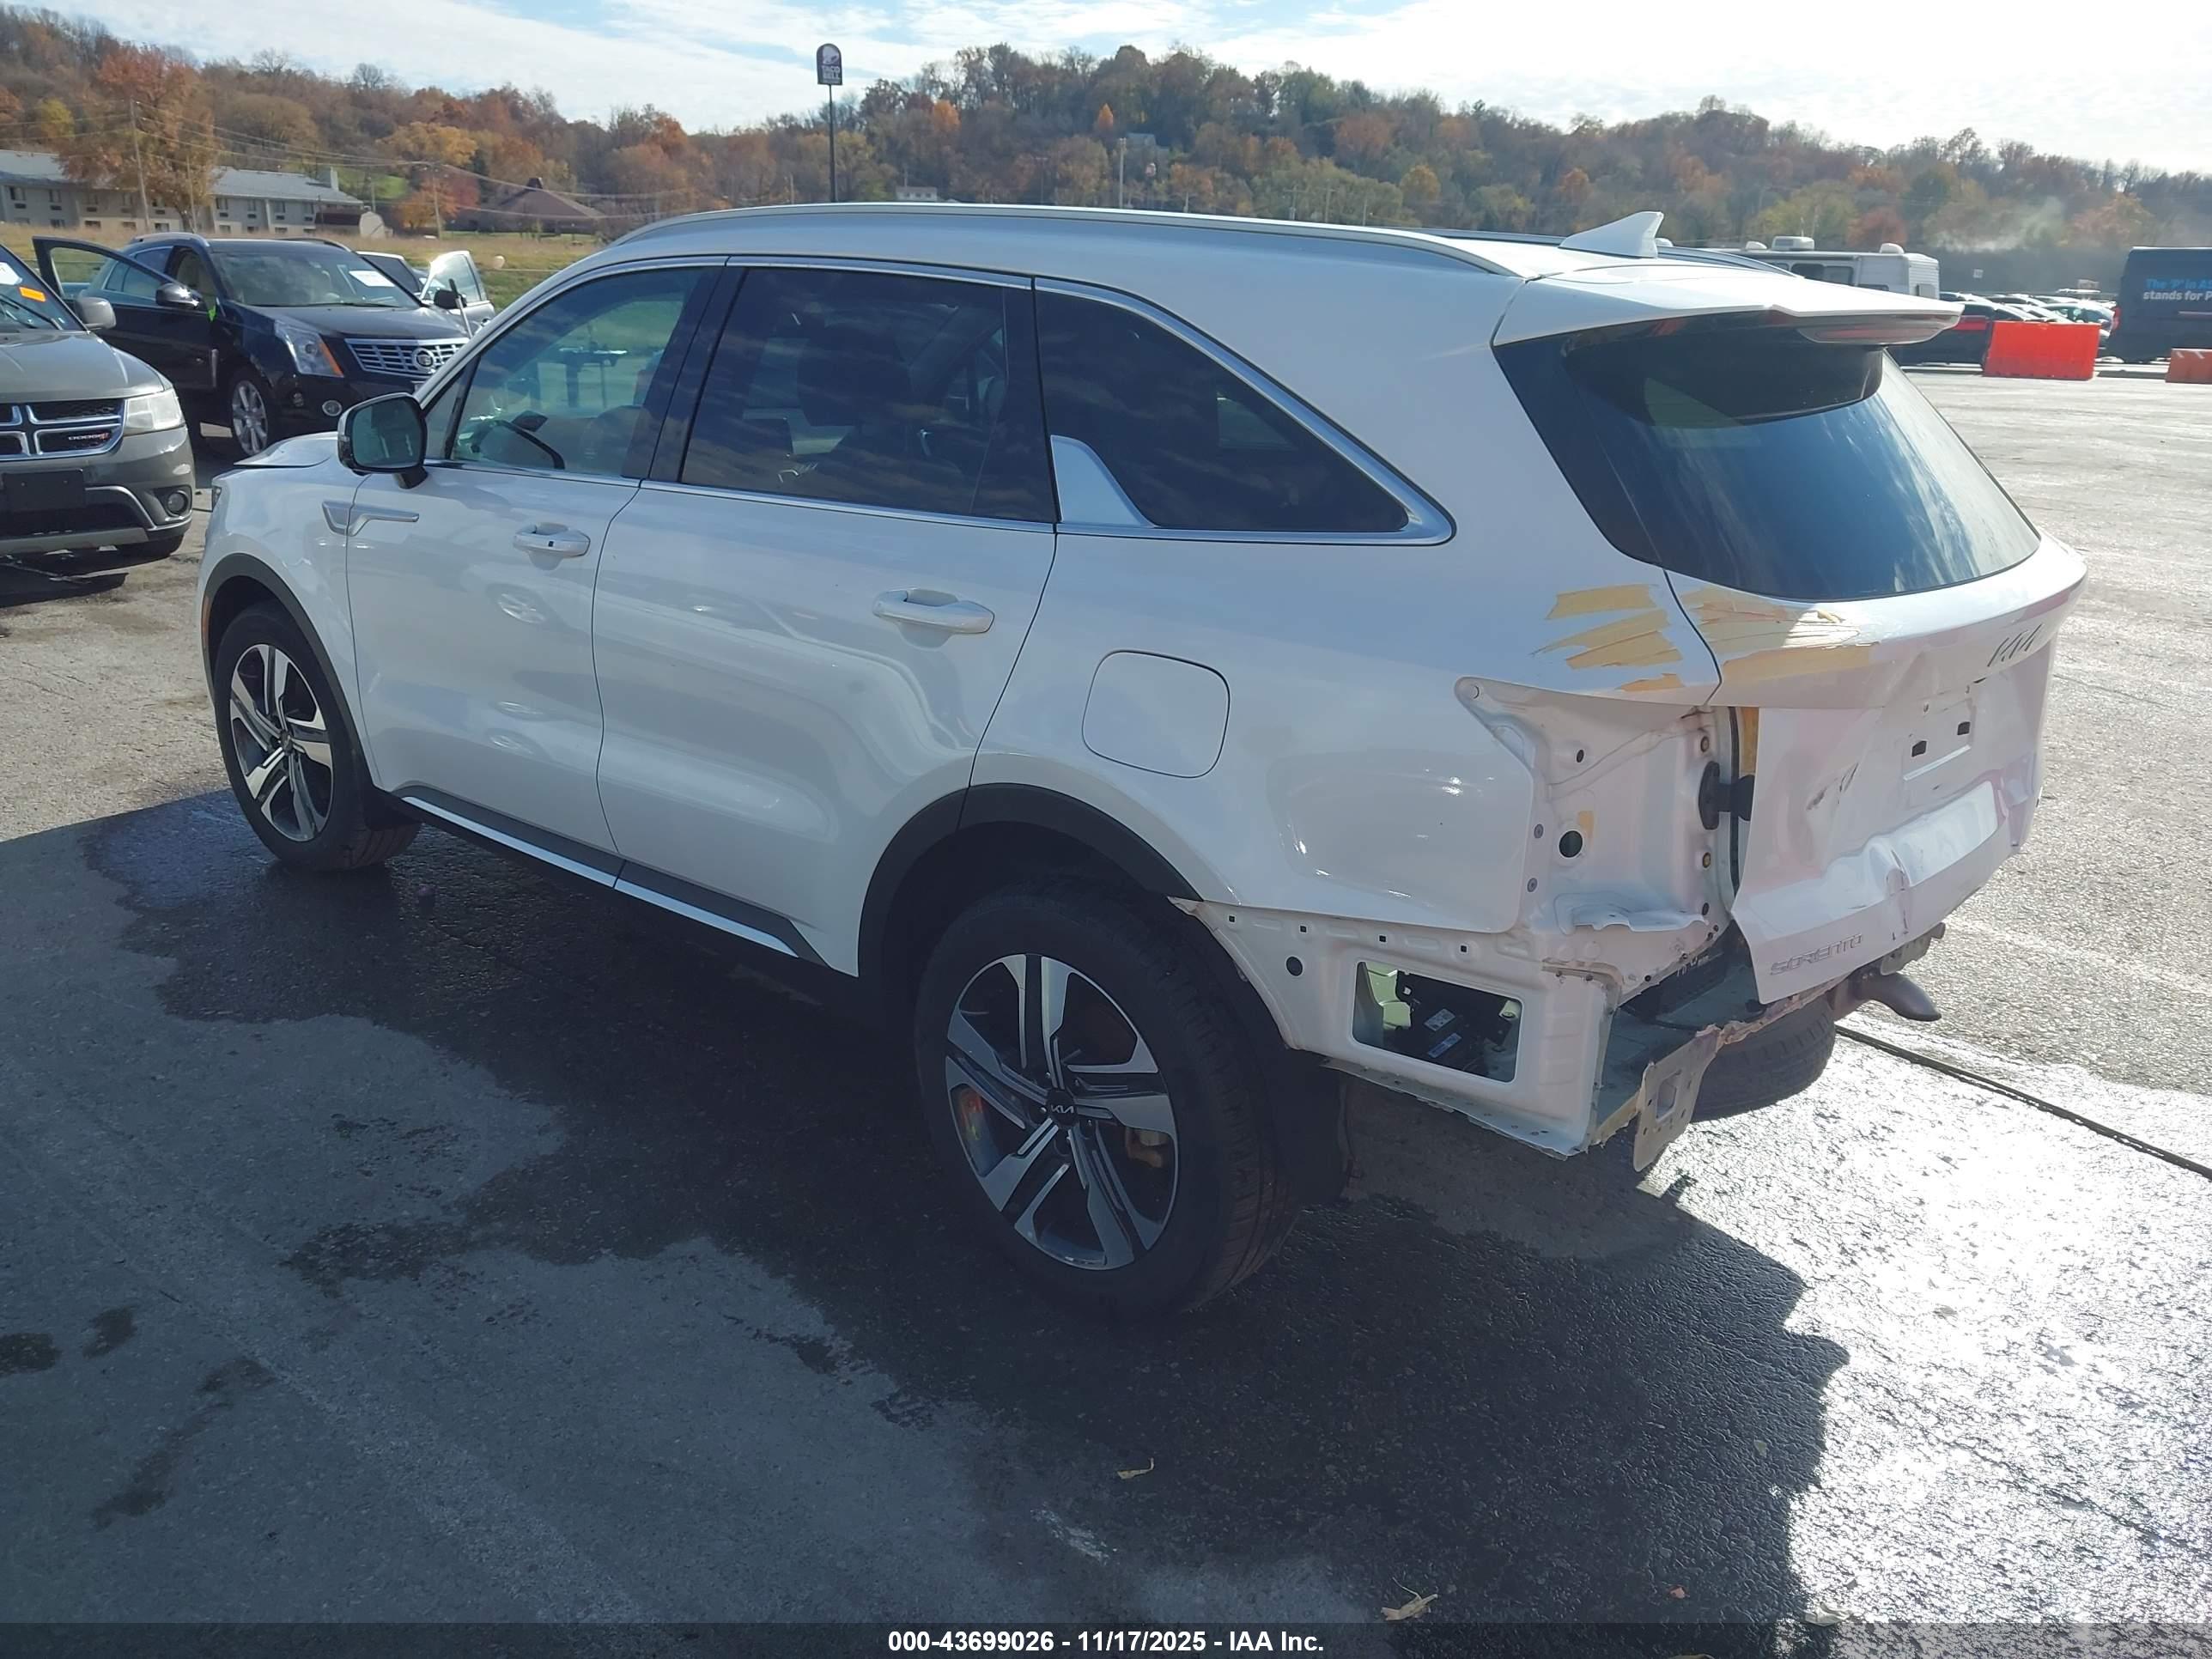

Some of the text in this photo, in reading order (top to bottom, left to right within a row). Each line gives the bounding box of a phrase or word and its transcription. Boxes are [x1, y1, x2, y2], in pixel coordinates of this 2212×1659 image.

[2143, 290, 2183, 301] stands
[2184, 290, 2203, 301] for
[1770, 933, 1863, 975] SORENTO
[1050, 1104, 1074, 1114] KIA
